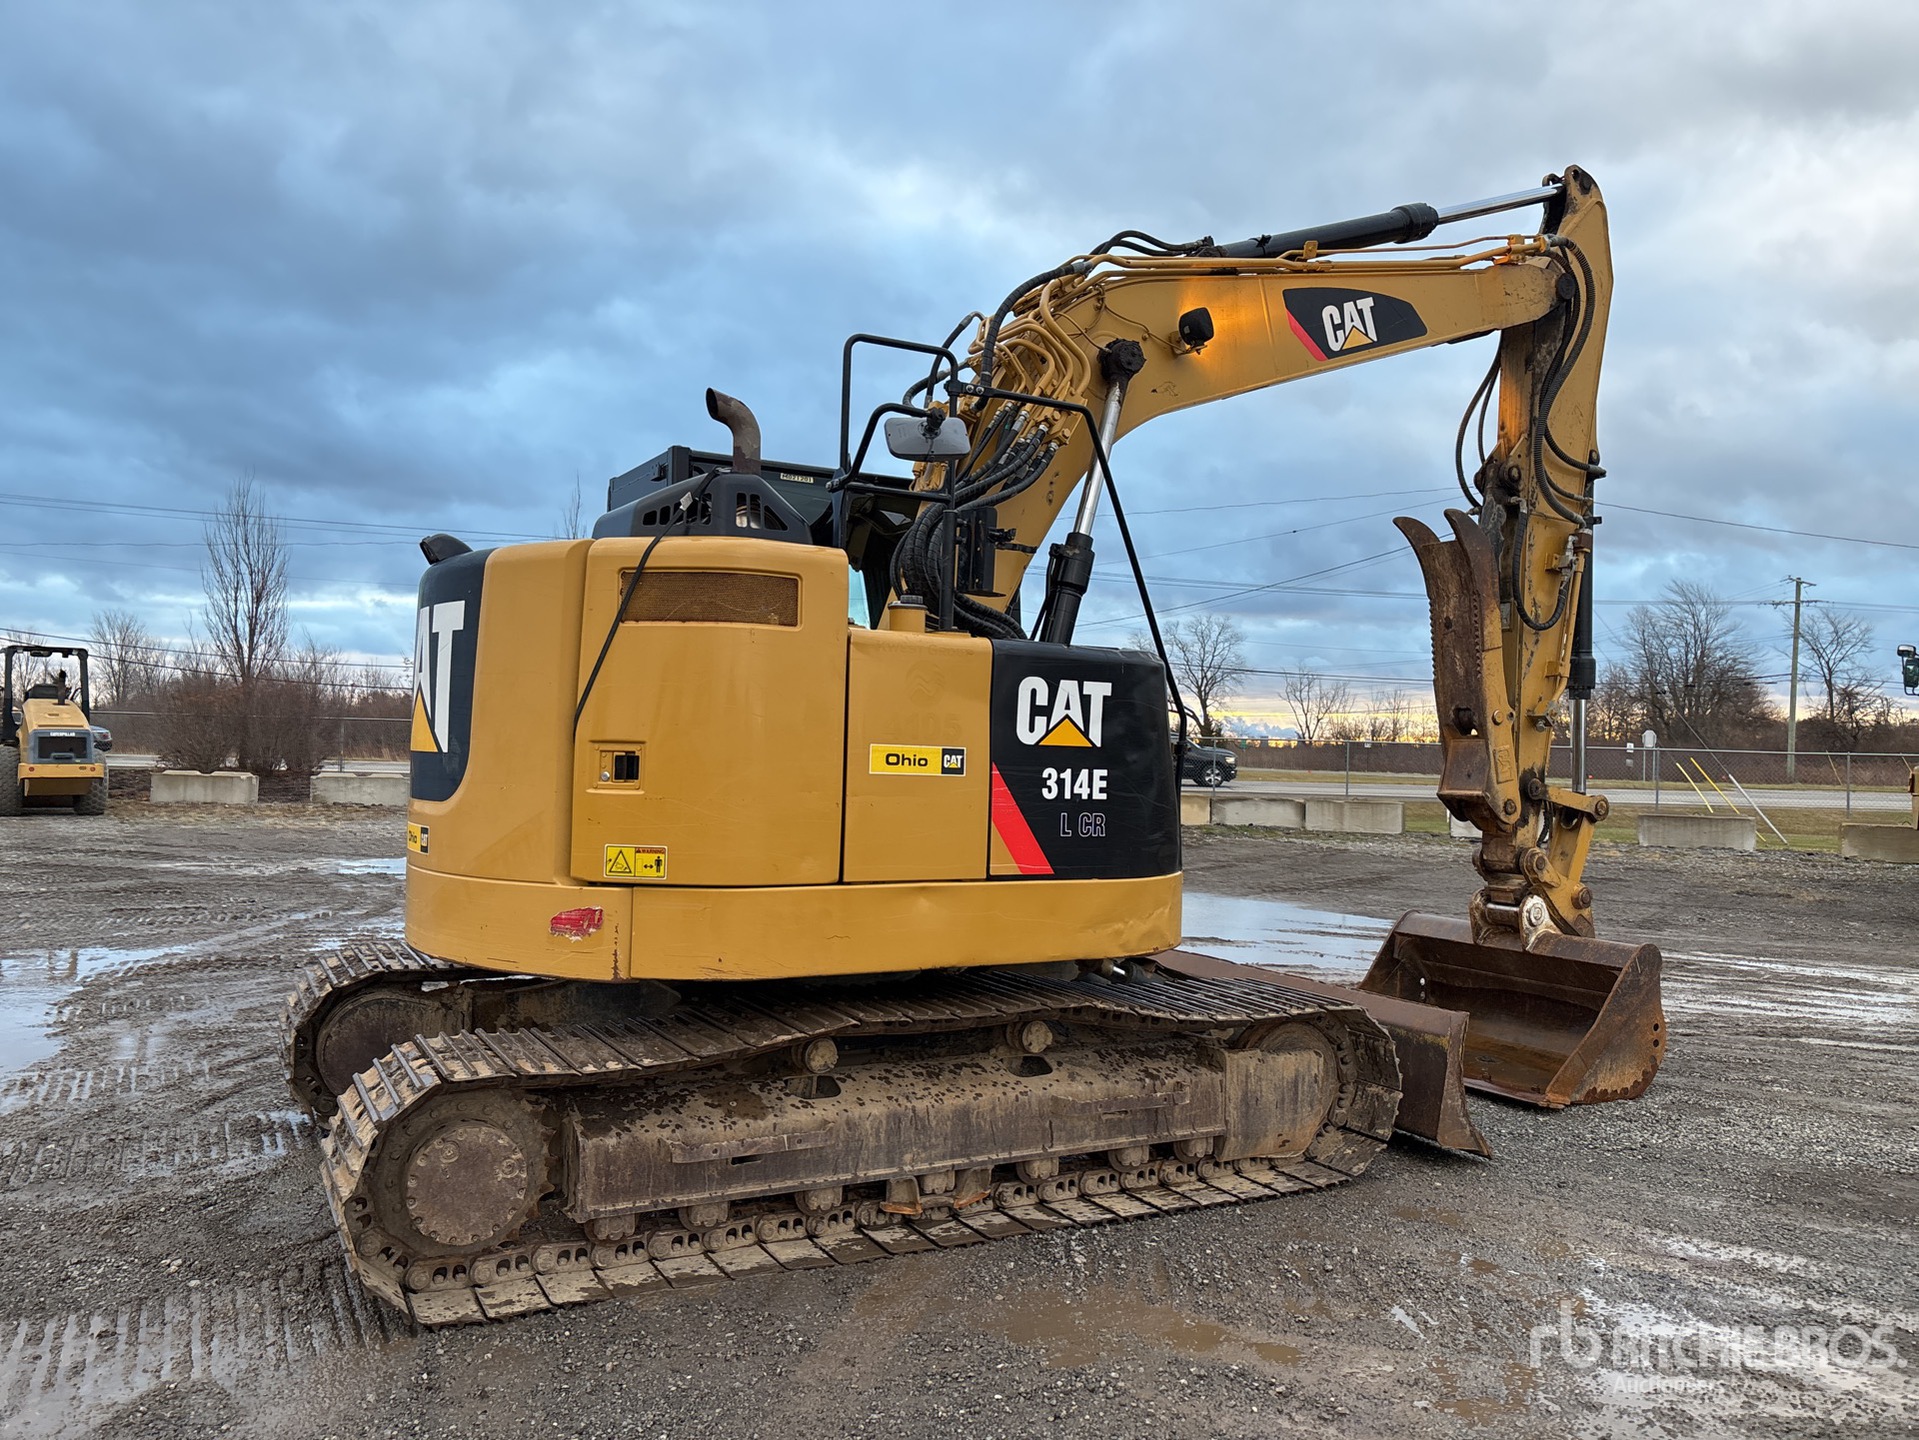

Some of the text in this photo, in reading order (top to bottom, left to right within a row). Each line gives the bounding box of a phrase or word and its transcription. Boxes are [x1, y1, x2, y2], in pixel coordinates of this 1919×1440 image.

[1321, 296, 1378, 352] CAT
[411, 600, 466, 754] AT
[1016, 675, 1112, 748] CAT
[885, 753, 963, 769] Ohio CAT
[1041, 767, 1108, 800] 314E
[1060, 812, 1106, 837] L CR
